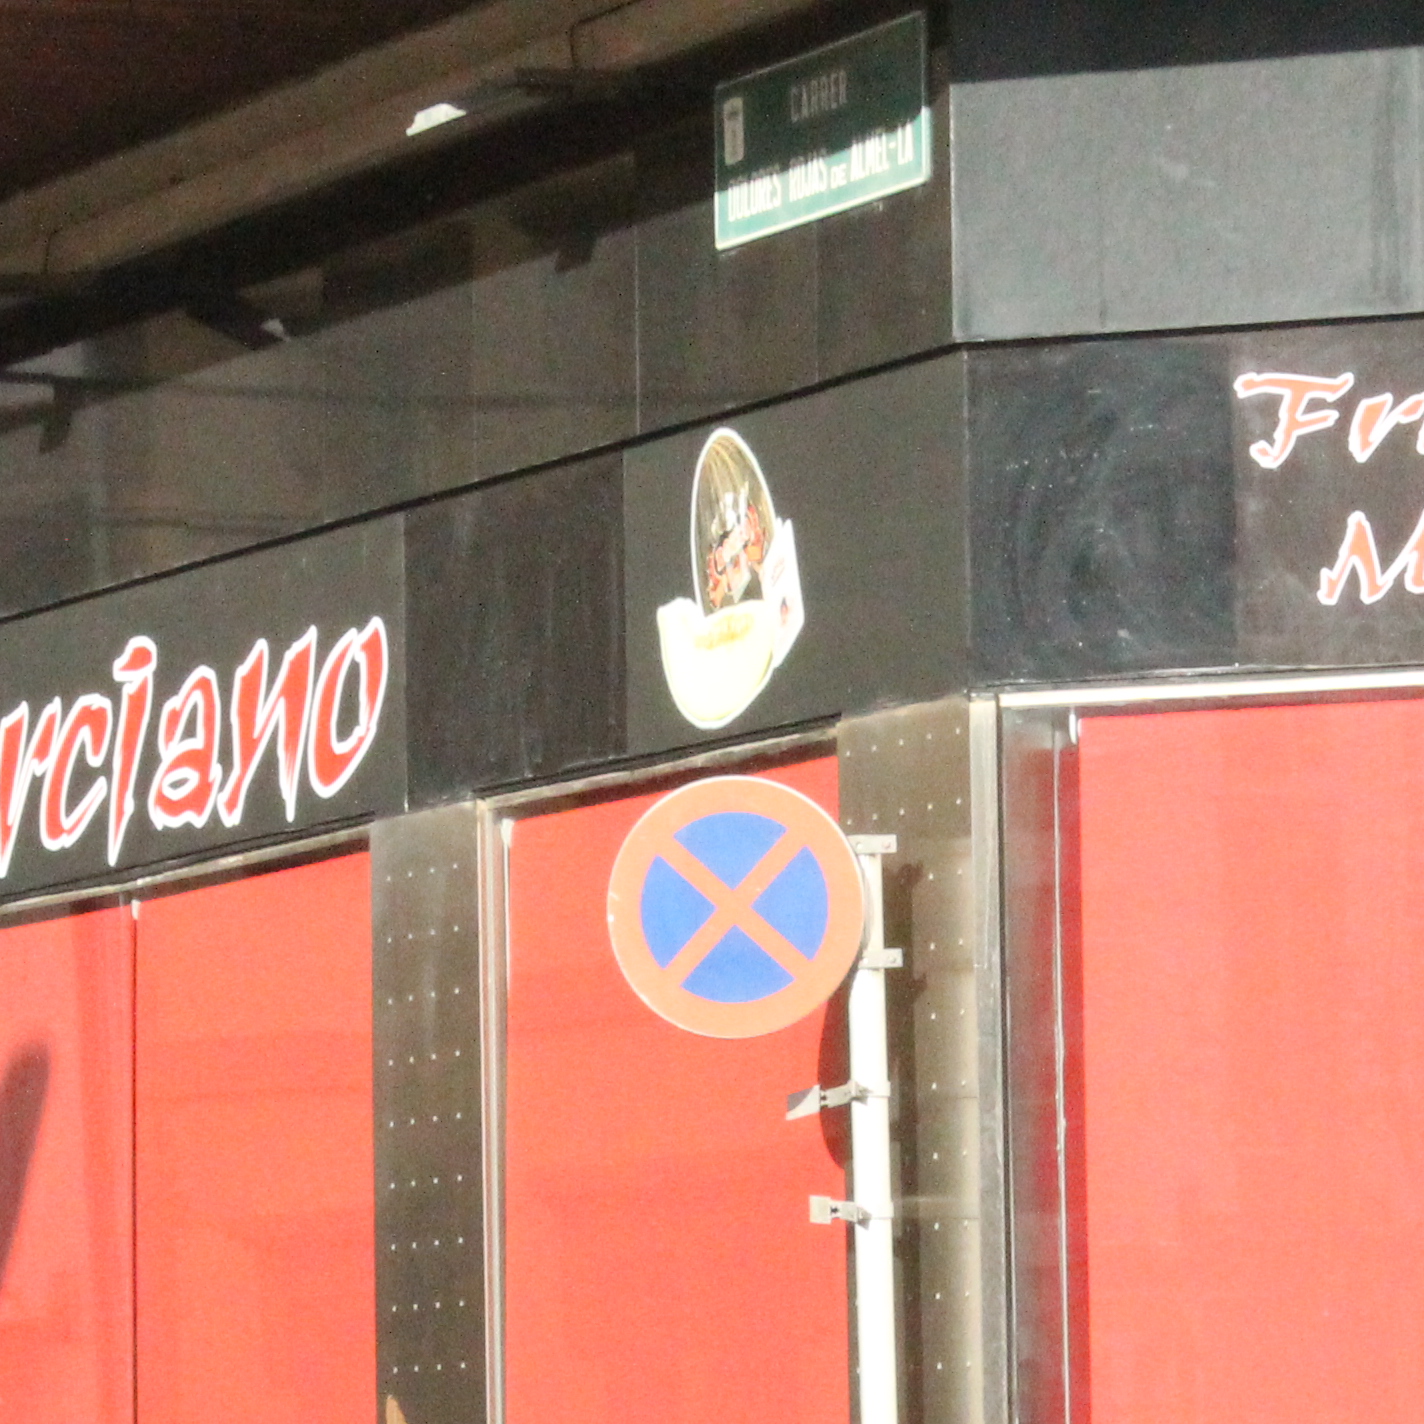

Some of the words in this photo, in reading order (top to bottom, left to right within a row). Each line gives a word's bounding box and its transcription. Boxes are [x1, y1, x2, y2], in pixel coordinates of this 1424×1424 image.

[790, 69, 847, 123] CARRER
[728, 164, 782, 222] DOLORES
[788, 150, 828, 203] ROJAS
